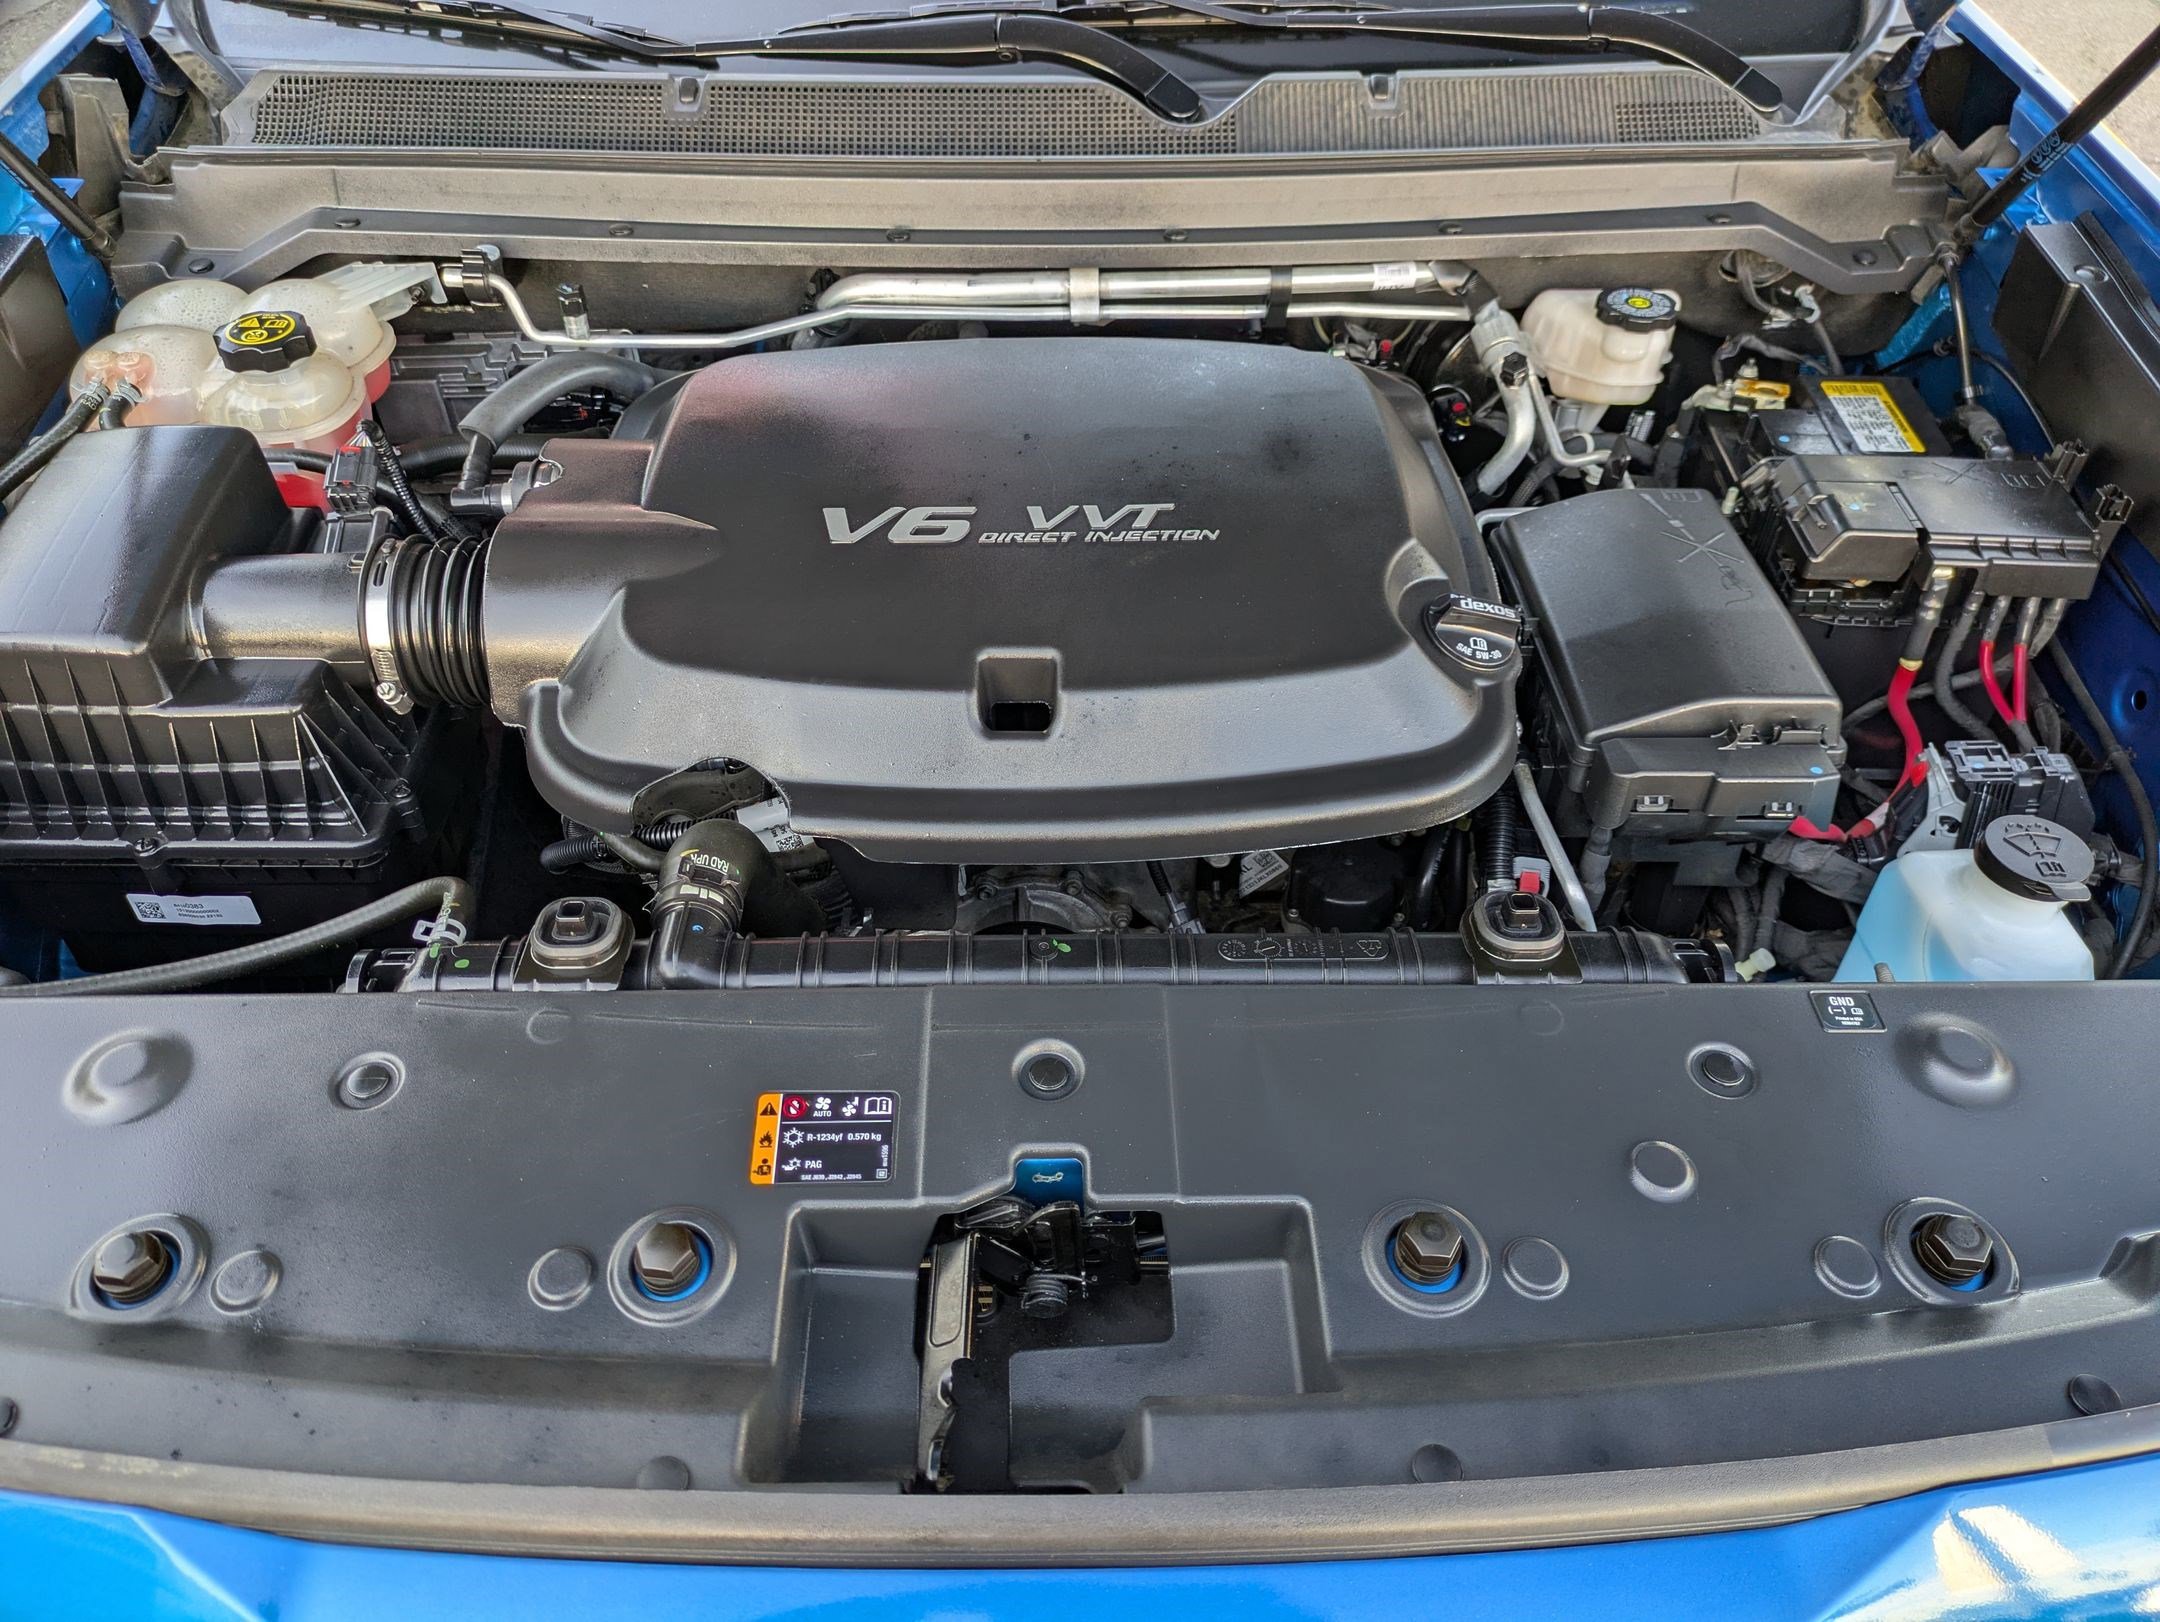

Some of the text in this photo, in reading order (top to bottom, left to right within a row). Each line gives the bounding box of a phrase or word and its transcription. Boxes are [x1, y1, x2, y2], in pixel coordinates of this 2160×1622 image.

[822, 506, 977, 543] V6
[1026, 503, 1175, 529] VVT
[978, 529, 1220, 543] DIRECT INJECTION
[1460, 598, 1516, 618] dexos
[1456, 643, 1502, 660] SAE 5W-30
[711, 856, 730, 873] RAD
[1828, 996, 1855, 1006] GND
[807, 1133, 882, 1142] R-1234yf 0.570 kg
[805, 1160, 822, 1169] PAG
